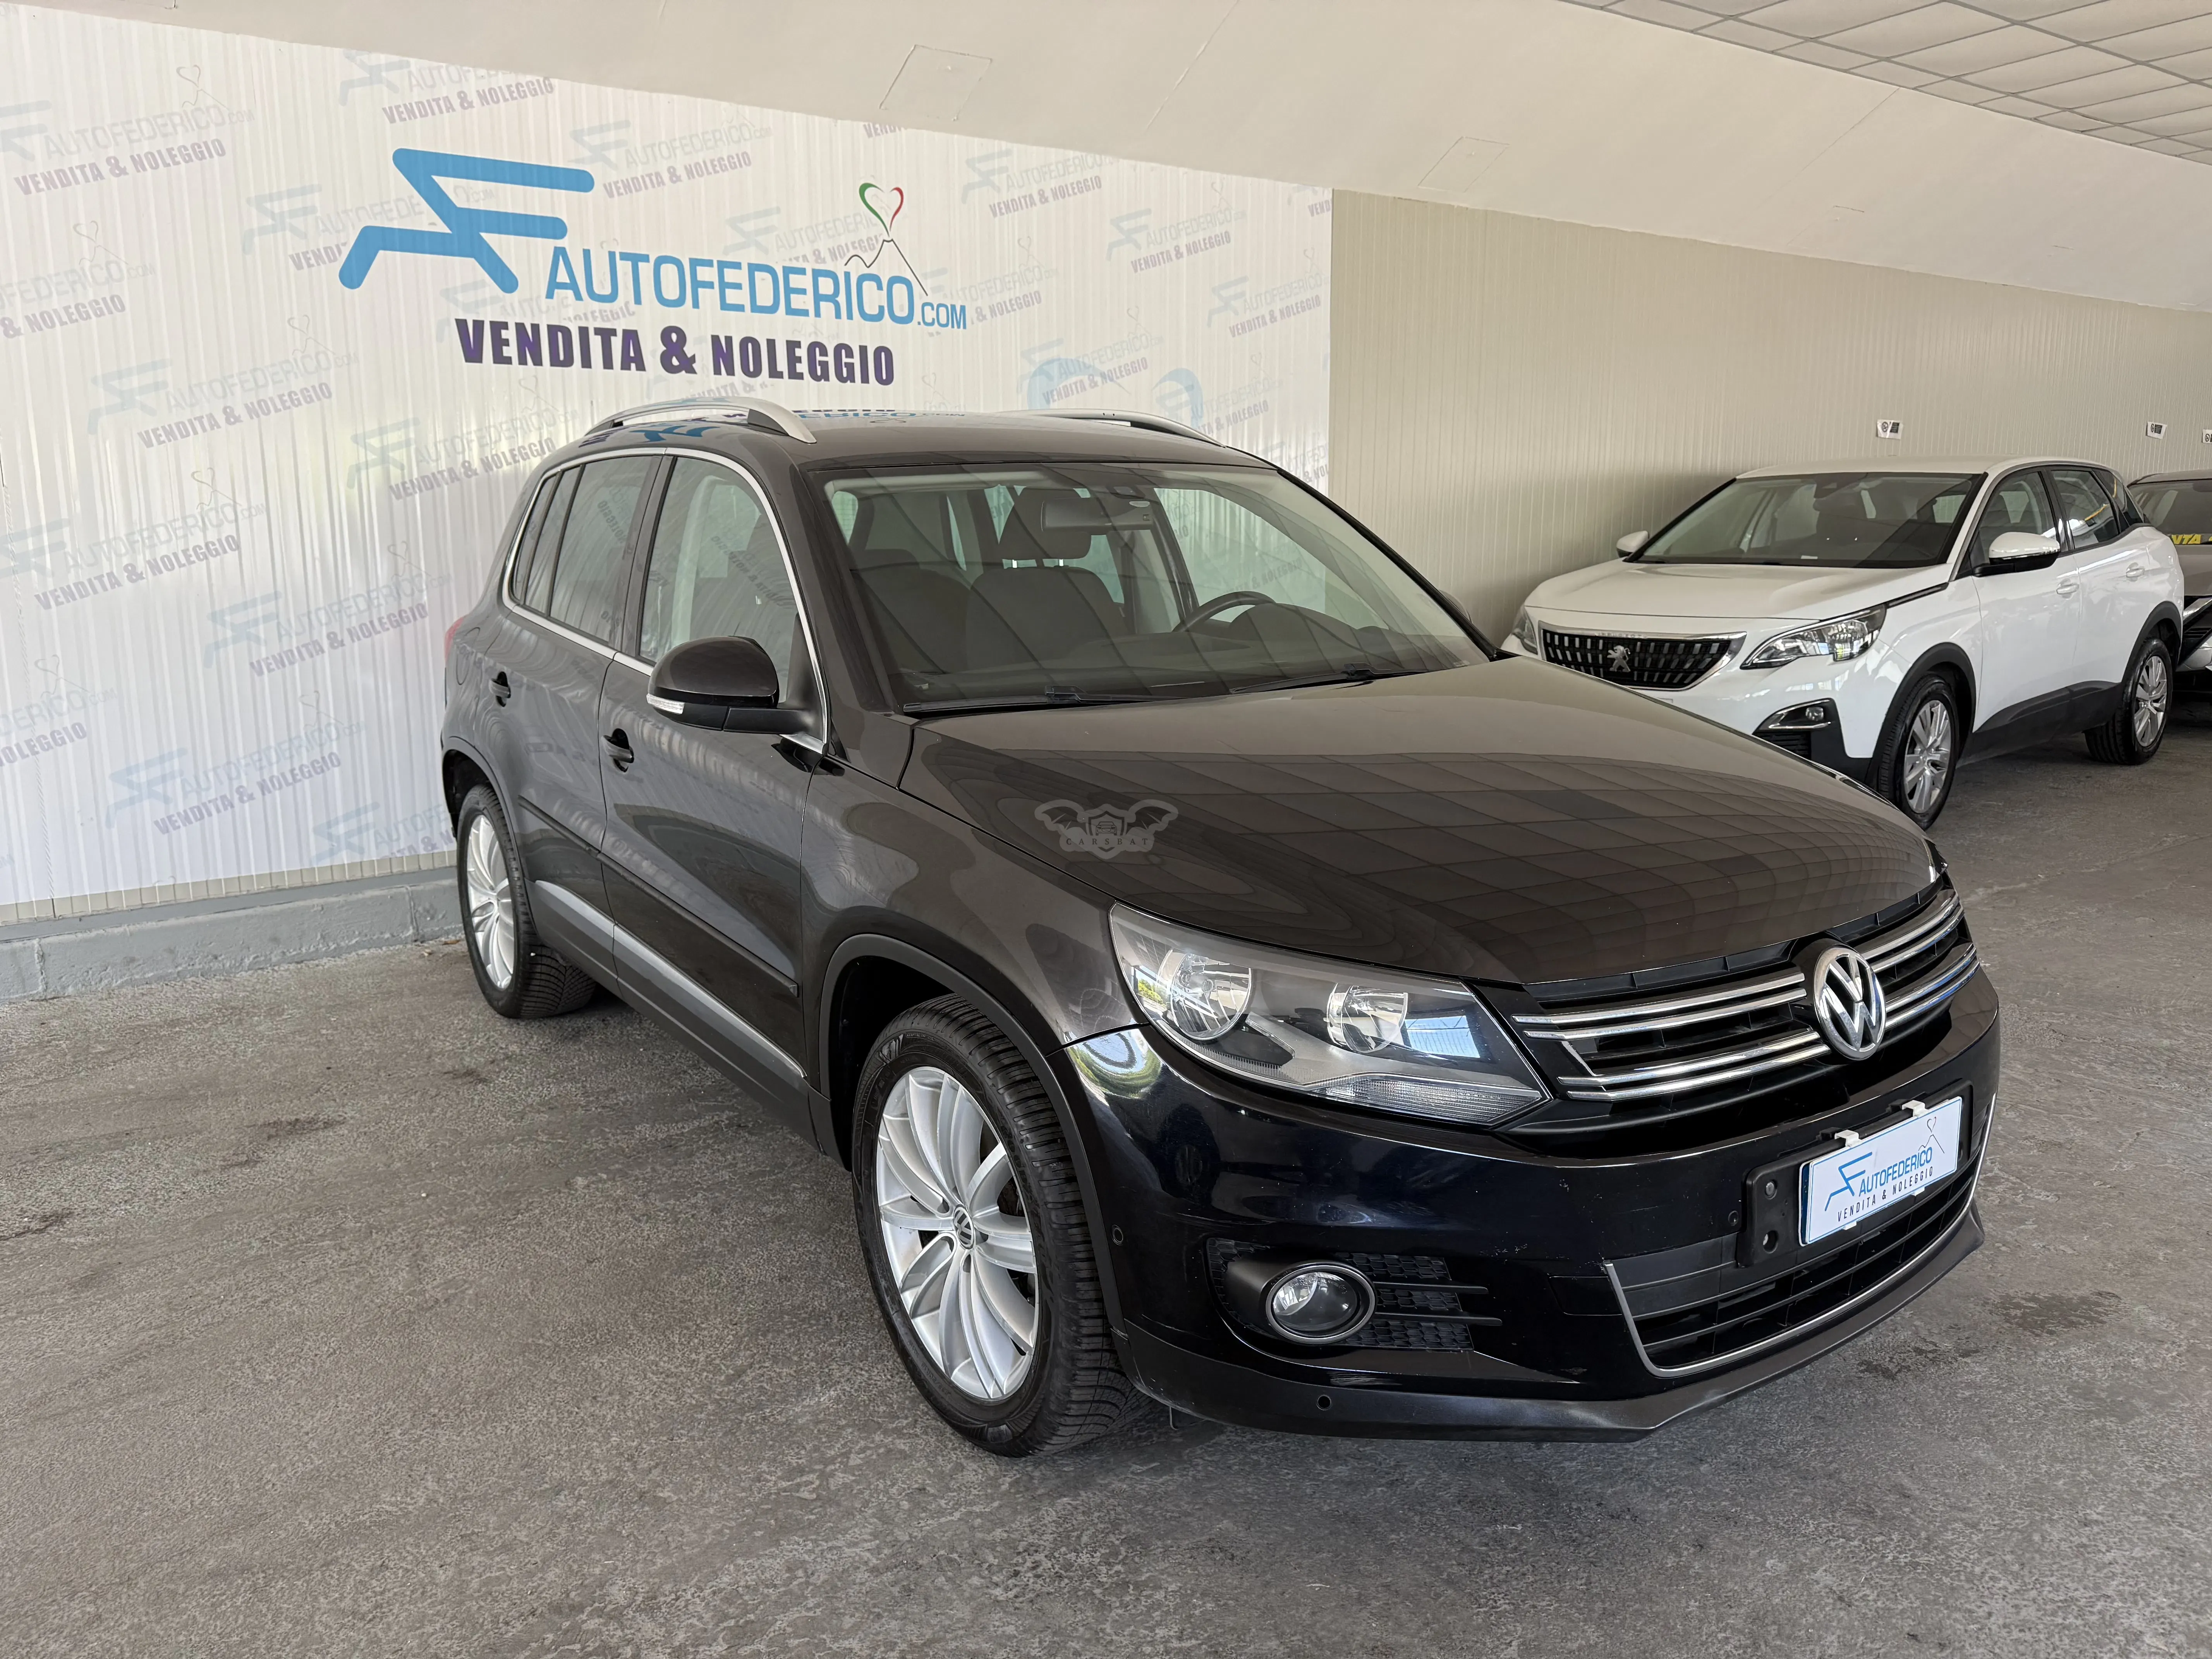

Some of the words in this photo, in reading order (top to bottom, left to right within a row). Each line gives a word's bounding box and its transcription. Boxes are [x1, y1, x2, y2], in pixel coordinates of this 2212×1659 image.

[382, 95, 456, 124] VENDITA
[457, 90, 475, 110] &
[476, 77, 554, 106] NOLEGGIO
[14, 162, 105, 195] VENDITA
[105, 155, 129, 178] &
[130, 138, 227, 173] NOLEGGIO
[603, 172, 665, 199] VENDITA
[667, 165, 682, 184] &
[684, 151, 752, 181] NOLEGGIO
[989, 193, 1037, 218] VENDITA
[1037, 189, 1049, 204] &
[1050, 175, 1102, 201] NOLEGGIO
[813, 249, 827, 264] &
[828, 233, 883, 262] NOLEGGI
[1131, 250, 1172, 273] VENDITA
[1174, 245, 1183, 260] &
[1185, 231, 1231, 256] NOLEGGIO
[545, 246, 967, 330] AUTOFEDERICO.COM
[975, 306, 988, 323] &
[989, 290, 1042, 318] NOLEGGIO
[0, 316, 24, 338] &
[24, 294, 126, 333] NOLEGGIO
[1229, 314, 1267, 338] VENDITA
[1269, 309, 1277, 323] &
[1279, 295, 1321, 320] NOLEGGIO
[455, 318, 647, 372] VENDITA
[659, 325, 697, 374] &
[711, 335, 894, 386] NOLEGGIO
[1042, 379, 1086, 405] VENDITA
[1087, 374, 1099, 388] &
[1100, 357, 1148, 385] NOLEGGIO
[137, 413, 222, 448] VENDITA
[222, 405, 243, 425] &
[244, 382, 333, 420] NOLEGGIO
[1216, 417, 1224, 431] &
[1226, 400, 1269, 426] NOLEGGIO
[389, 469, 460, 500] VENDITA
[461, 460, 479, 479] &
[480, 437, 556, 467] NOLEGGIO
[34, 571, 123, 611] VENDITA
[123, 563, 145, 584] &
[146, 534, 241, 577] NOLEGGIO
[250, 640, 326, 677] VENDITA
[327, 631, 346, 650] &
[347, 602, 429, 643] NOLEGGIO
[154, 793, 235, 835] VENDITA
[235, 785, 256, 804] &
[256, 752, 341, 797] NOLEGGIO
[421, 836, 439, 852] &
[1837, 1196, 1876, 1223] VENDITA
[1882, 1190, 1887, 1200] &
[1893, 1166, 1934, 1195] NOLEGGIO
[1858, 1146, 1932, 1197] AUTOFEDERICO
